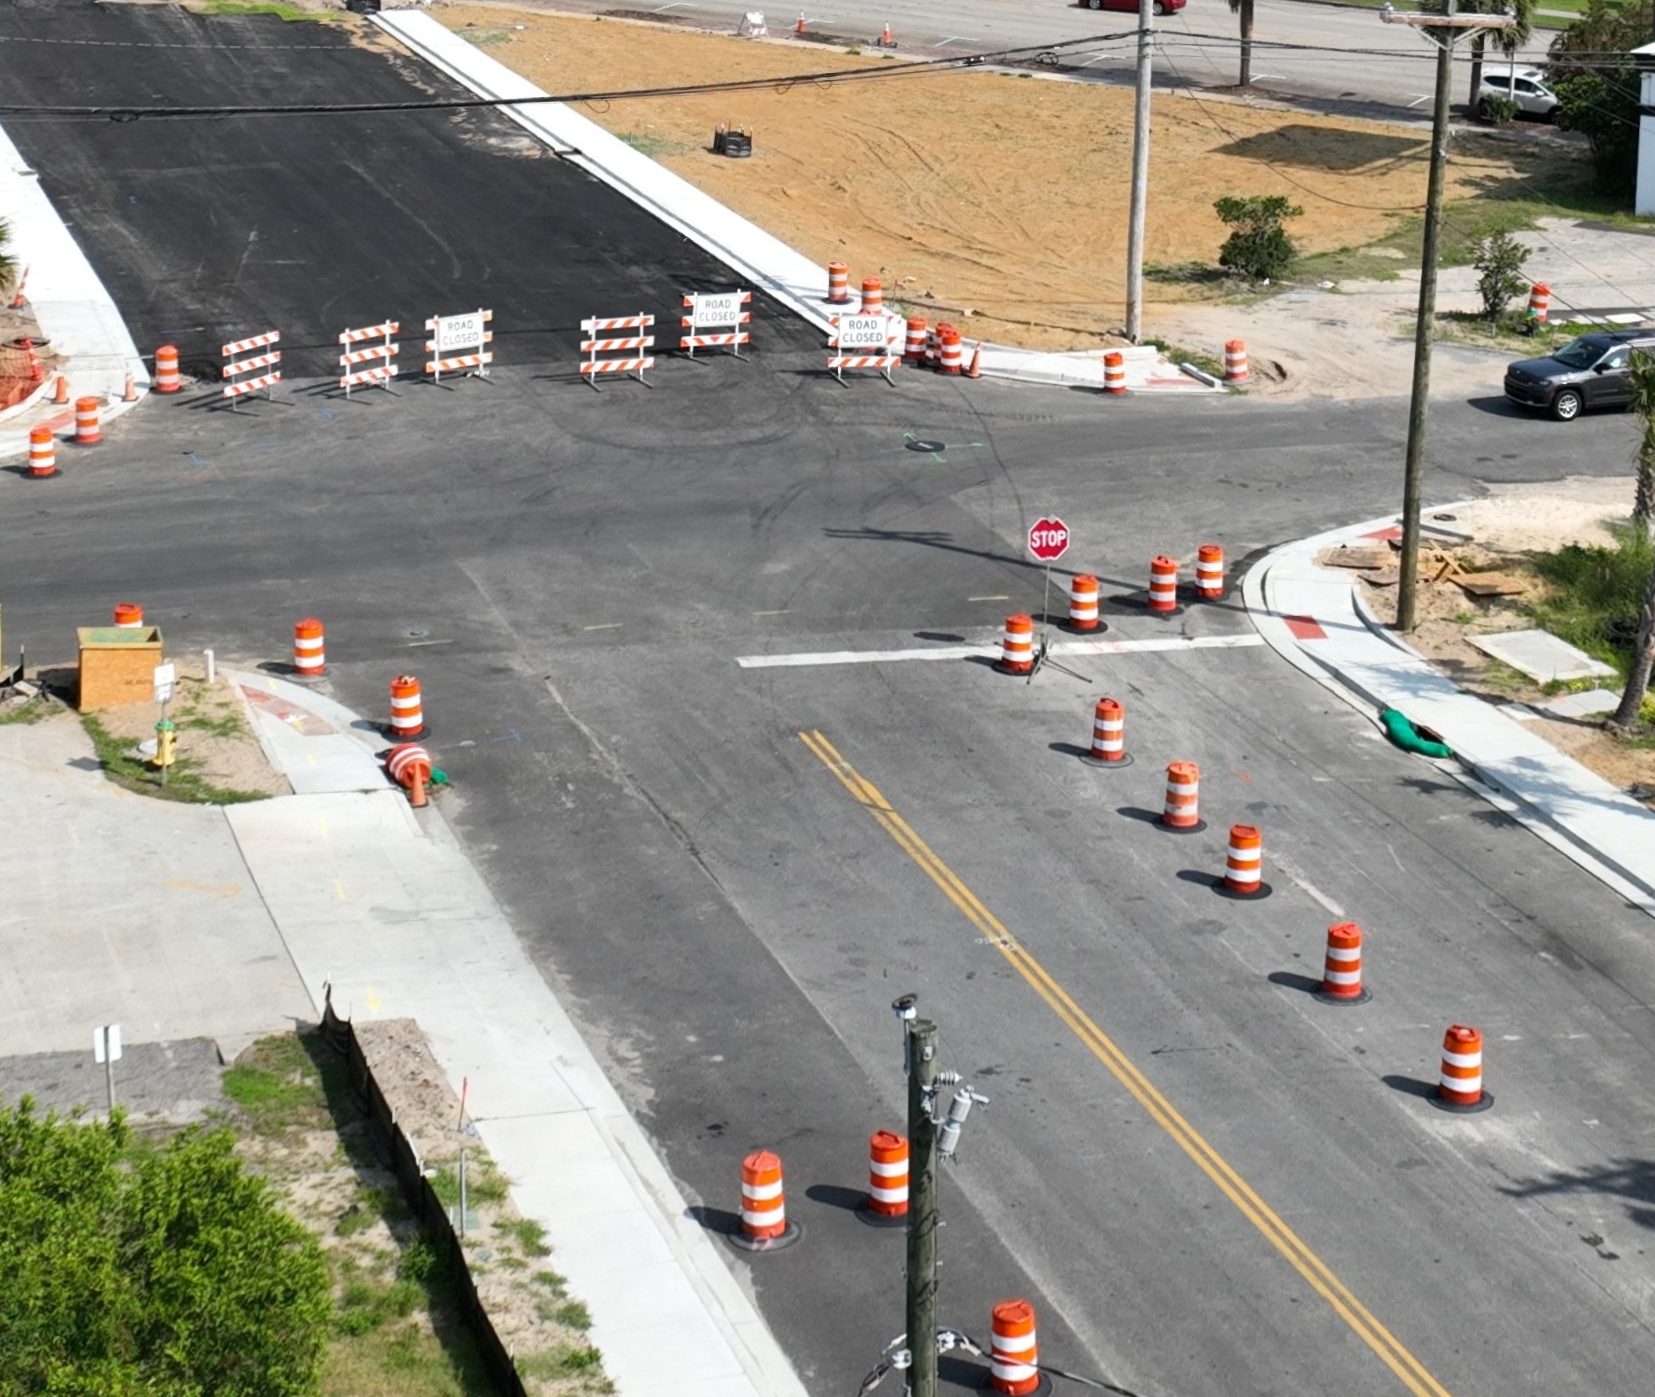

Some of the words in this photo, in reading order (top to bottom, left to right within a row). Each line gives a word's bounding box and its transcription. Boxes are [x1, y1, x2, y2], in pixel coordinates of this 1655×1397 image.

[705, 299, 731, 309] ROAD
[699, 311, 736, 322] CLOSED
[447, 320, 473, 331] ROAD
[848, 320, 878, 330] ROAD
[442, 332, 479, 345] CLOSED
[842, 333, 883, 343] CLOSED
[1031, 529, 1066, 548] STOP
